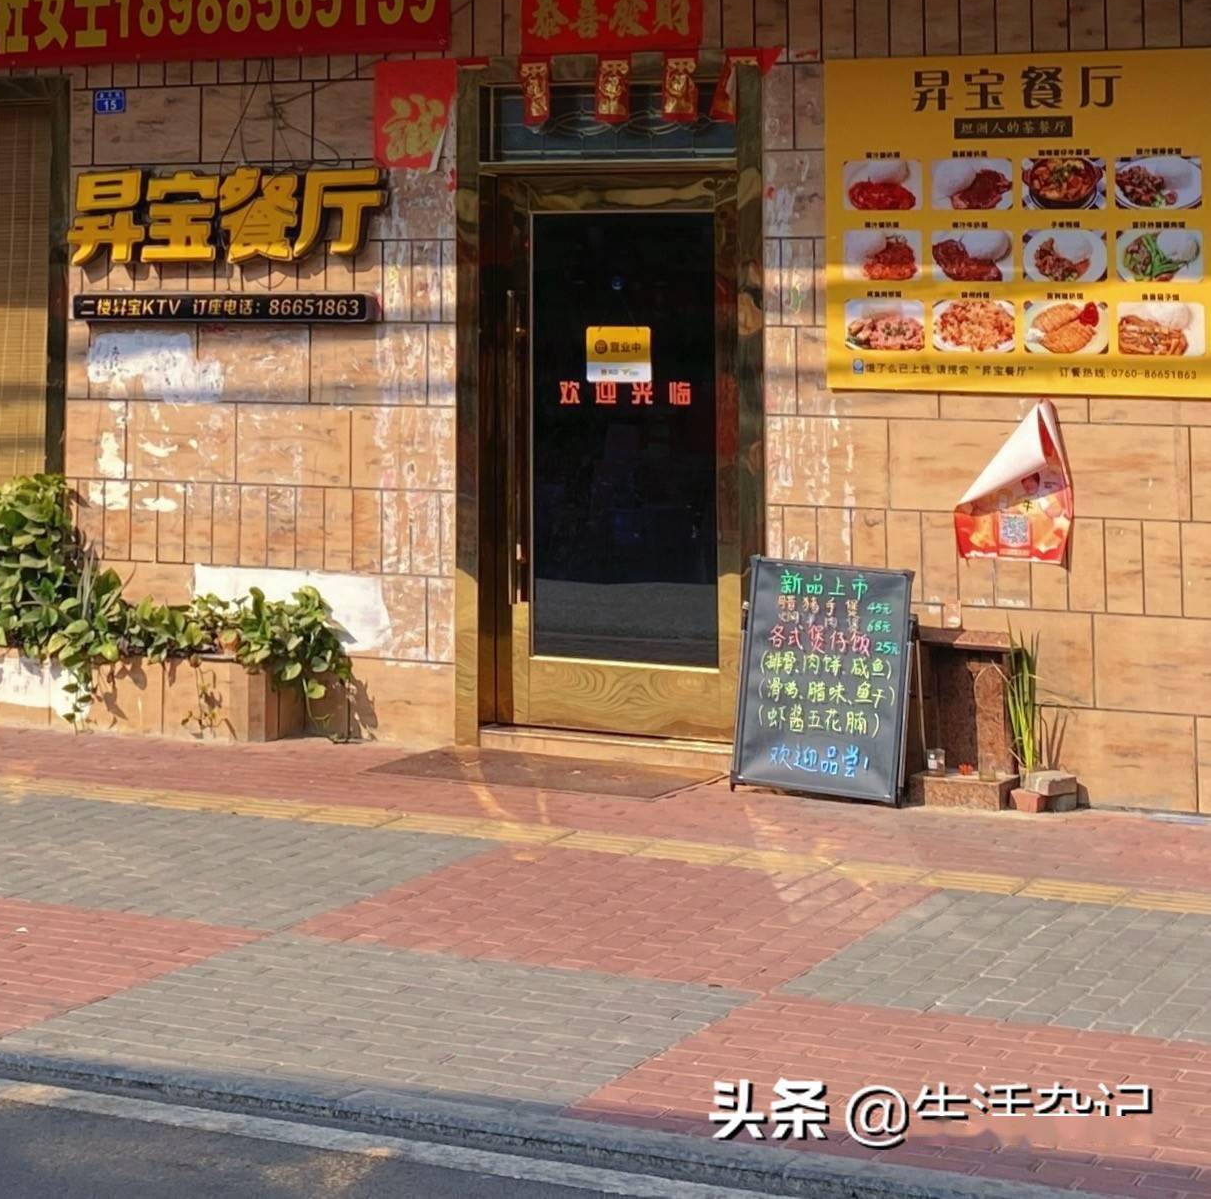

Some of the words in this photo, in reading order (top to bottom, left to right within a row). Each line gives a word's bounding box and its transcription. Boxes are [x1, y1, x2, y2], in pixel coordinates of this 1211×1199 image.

[911, 64, 1124, 112] 昇宝餐厅
[67, 165, 384, 266] 昇宝餐厅
[559, 380, 692, 406] 欢迎光临
[780, 569, 869, 601] 新品上市
